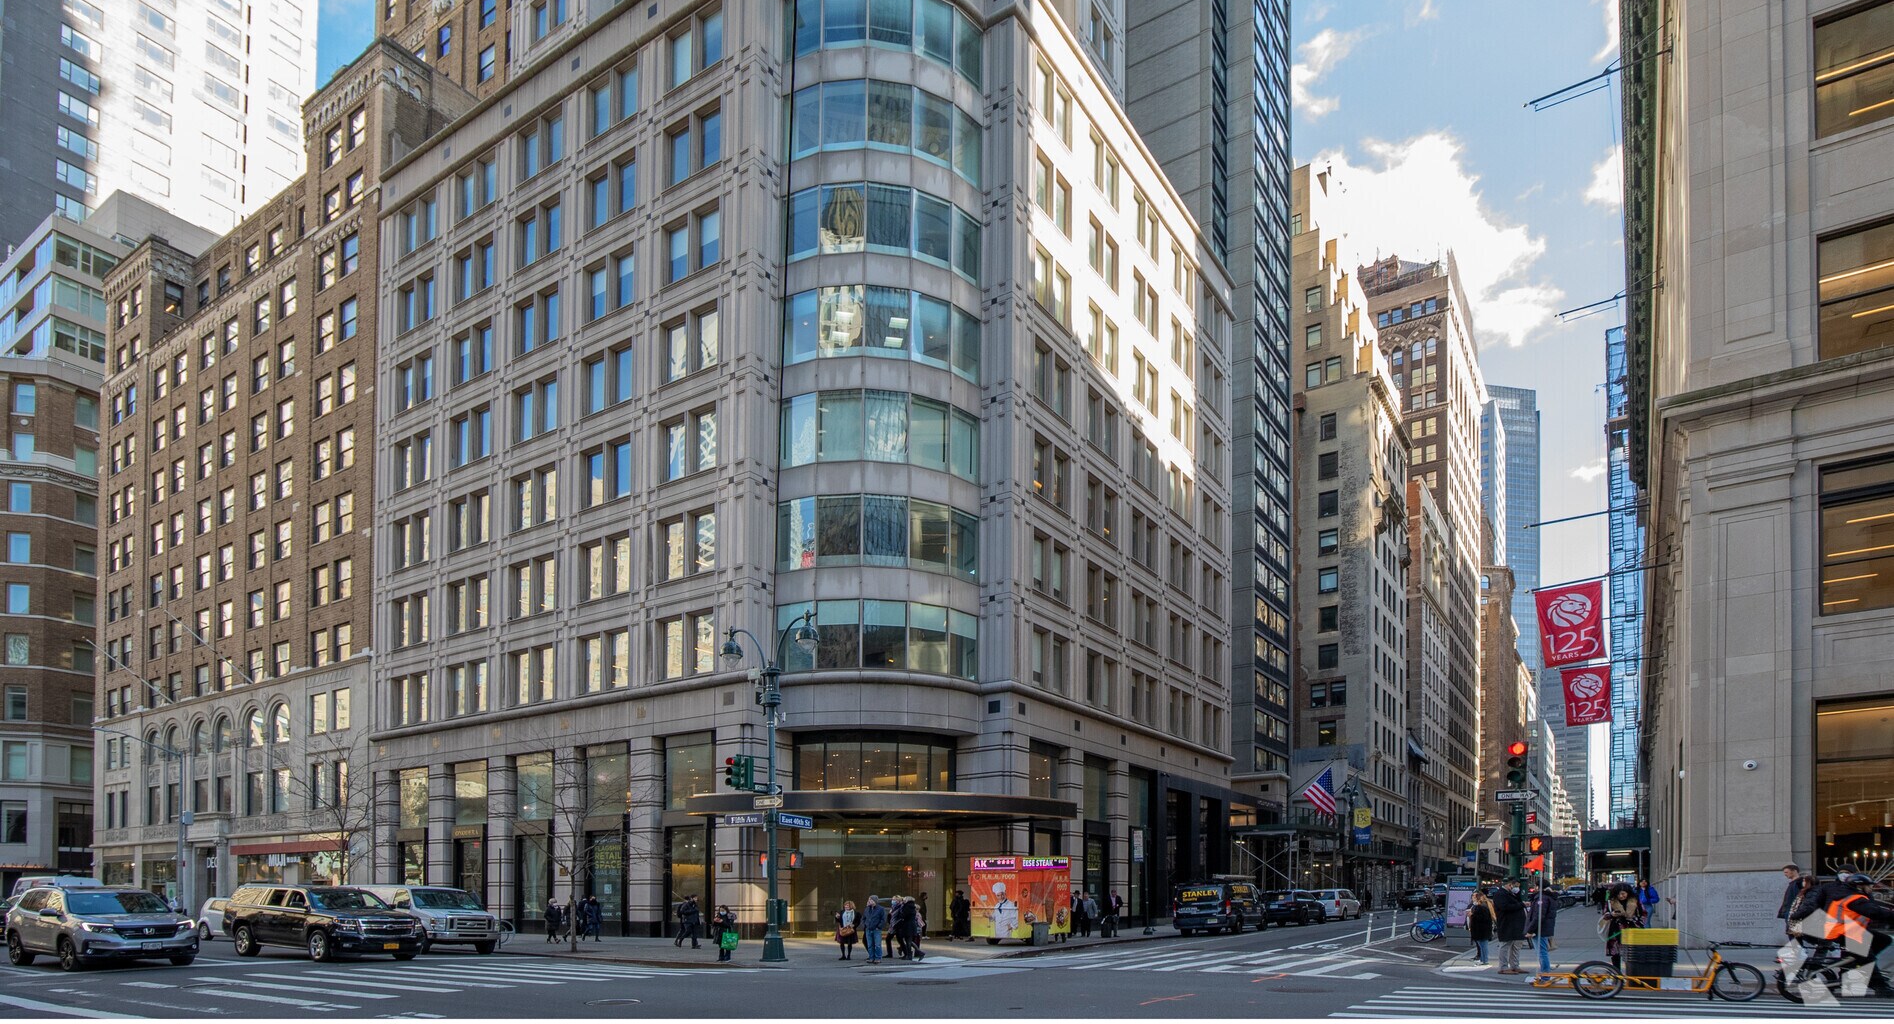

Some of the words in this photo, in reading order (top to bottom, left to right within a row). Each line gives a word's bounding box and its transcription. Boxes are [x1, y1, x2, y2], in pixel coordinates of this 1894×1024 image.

[1545, 625, 1599, 656] 125
[1551, 652, 1579, 661] YEARS
[1569, 698, 1607, 721] 125
[730, 816, 745, 824] Fifth
[781, 816, 793, 824] East
[804, 819, 811, 827] St
[594, 851, 622, 860] RETAIL
[268, 854, 287, 867] MUJI
[594, 860, 621, 869] SPACE
[1036, 858, 1054, 867] STEAK
[1182, 890, 1218, 898] STANLEY
